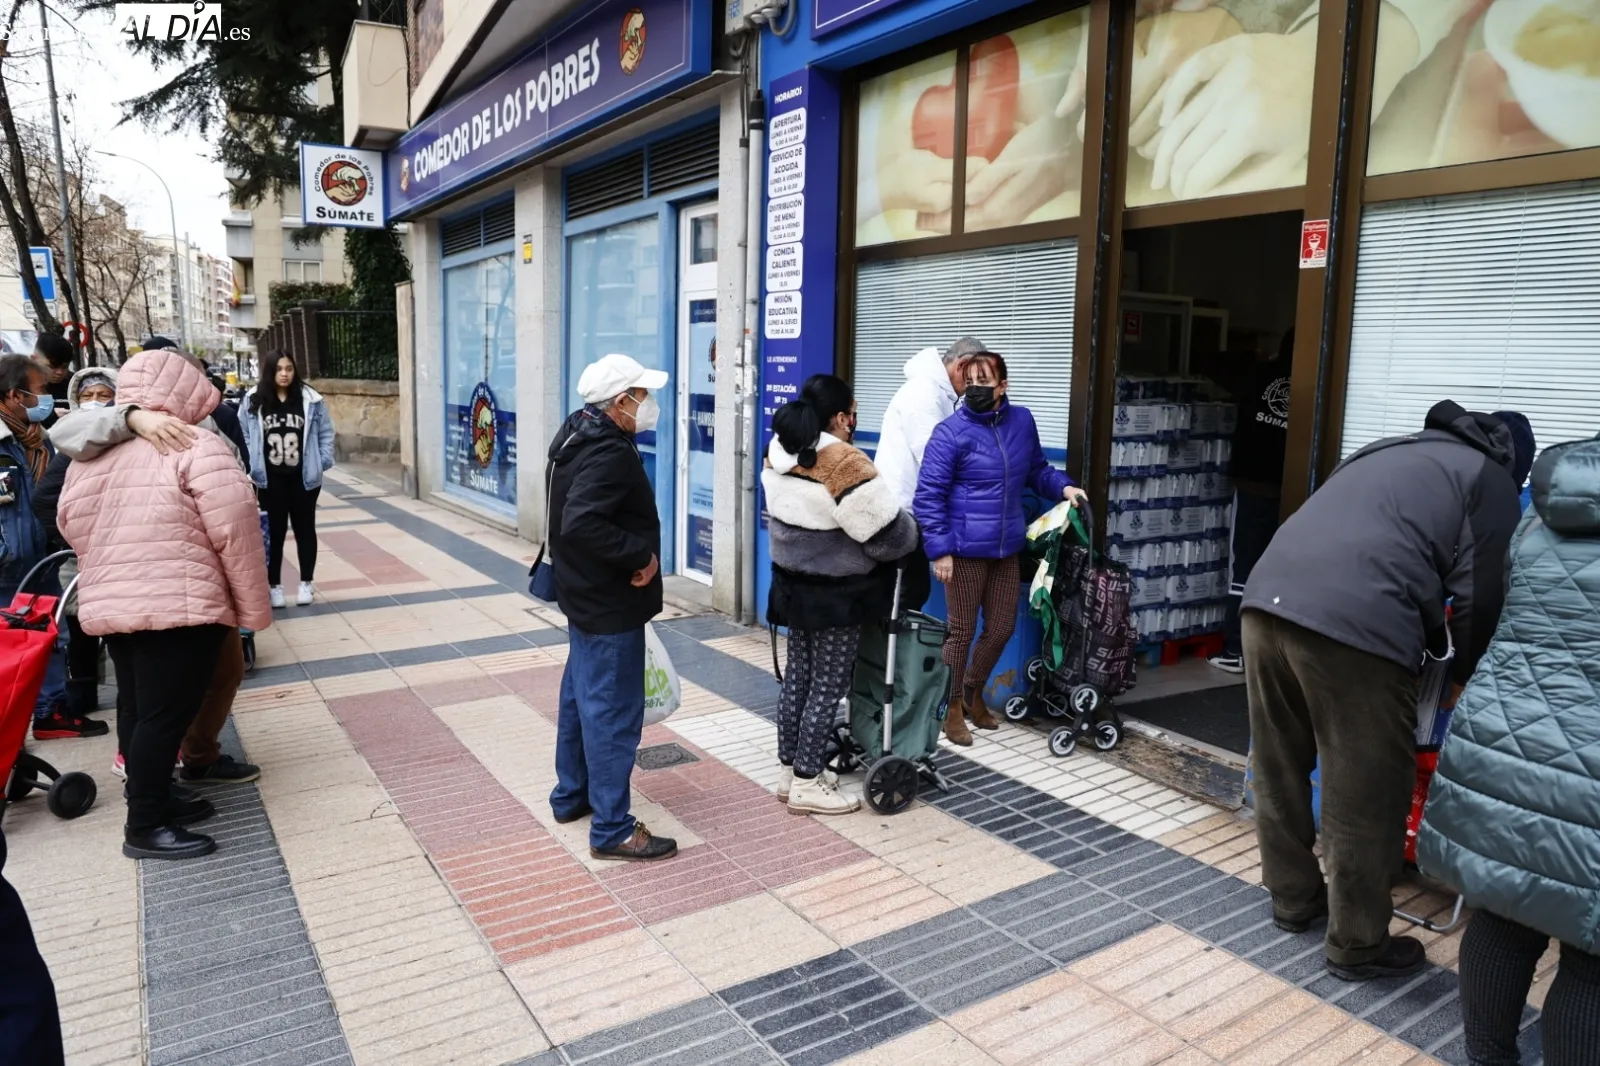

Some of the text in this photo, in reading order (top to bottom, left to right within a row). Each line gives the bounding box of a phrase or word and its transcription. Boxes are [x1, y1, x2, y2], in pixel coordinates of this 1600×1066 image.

[774, 86, 803, 104] HORARIOS
[414, 37, 601, 183] COMEDOR DE LOS POBRES
[774, 113, 802, 128] APERTURA
[771, 147, 803, 163] SERVICIO DE
[774, 160, 799, 174] ACOGIDA
[316, 206, 375, 222] SÚMATE
[774, 246, 795, 257] COMIDA
[772, 258, 797, 269] CALIENTE
[774, 294, 792, 303] MISIÓN
[768, 306, 798, 316] EDUCATIVA
[1255, 411, 1289, 429] SÚMA
